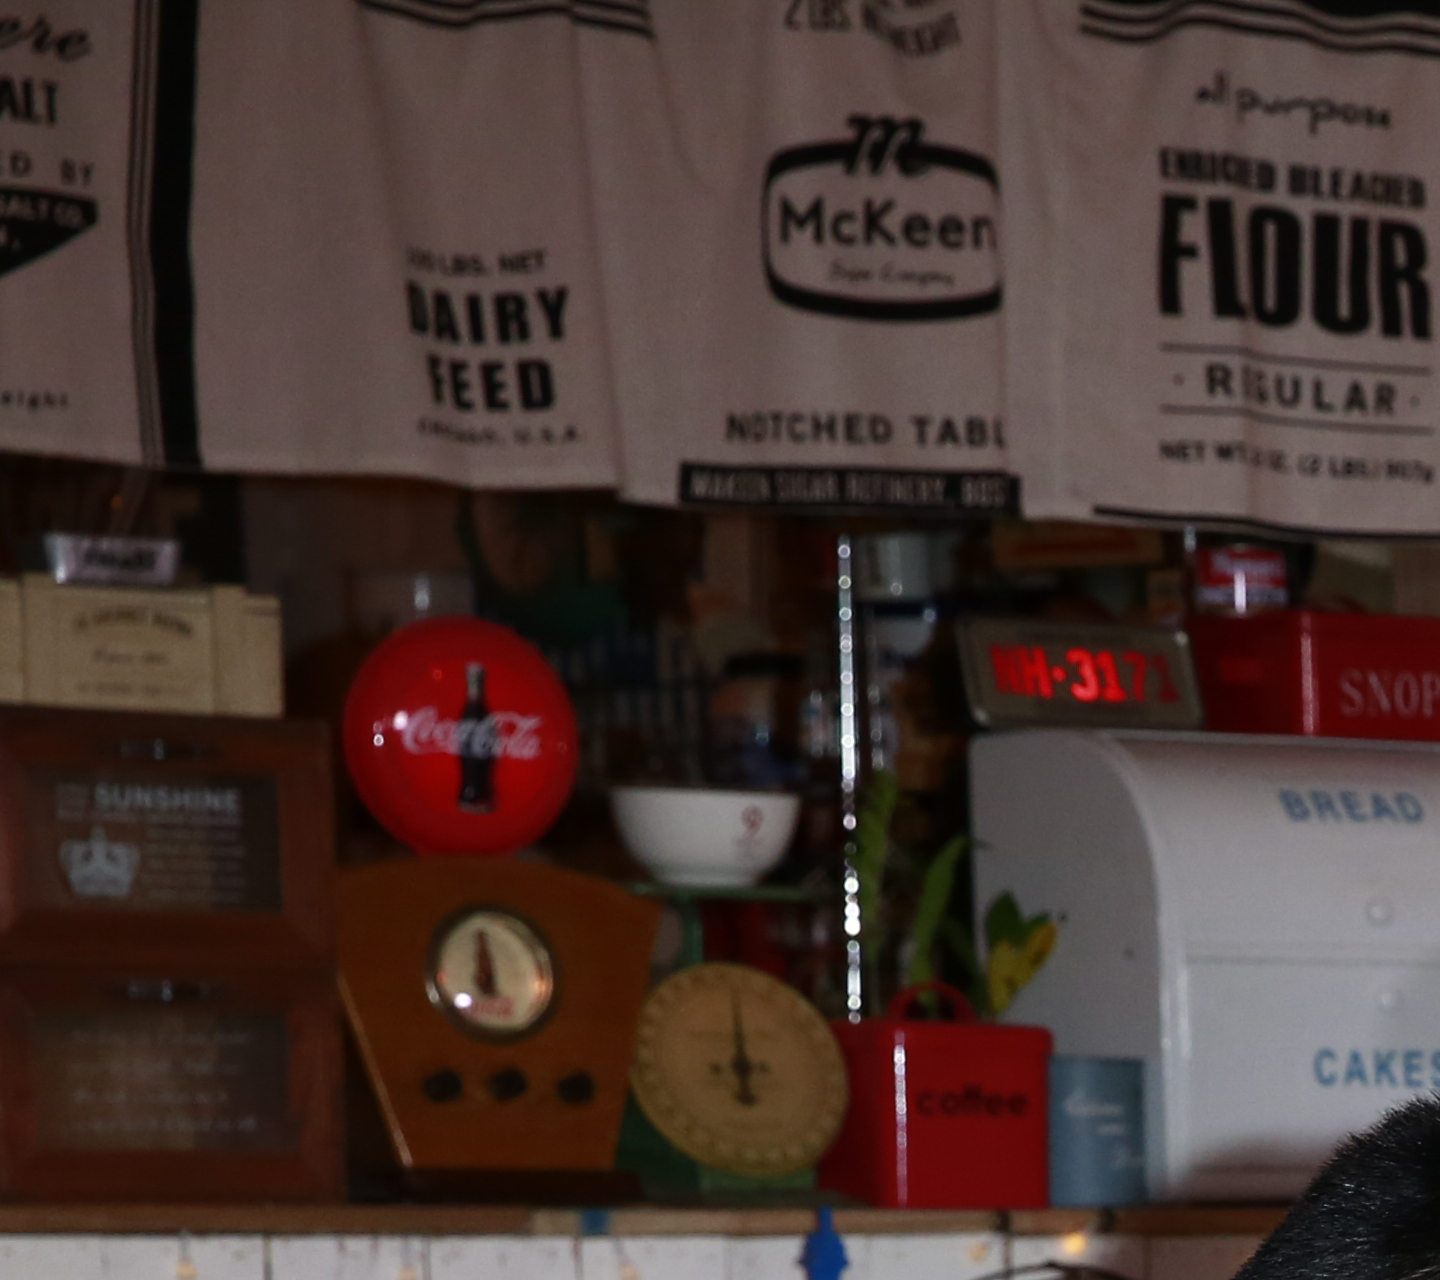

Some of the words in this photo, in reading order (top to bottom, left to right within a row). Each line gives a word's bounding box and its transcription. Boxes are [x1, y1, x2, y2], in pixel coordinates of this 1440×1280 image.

[1157, 192, 1432, 342] FLOUR
[405, 279, 570, 345] DAIRY
[426, 352, 557, 414] FEED
[1278, 789, 1425, 825] BREAD
[915, 1085, 1029, 1121] coffee
